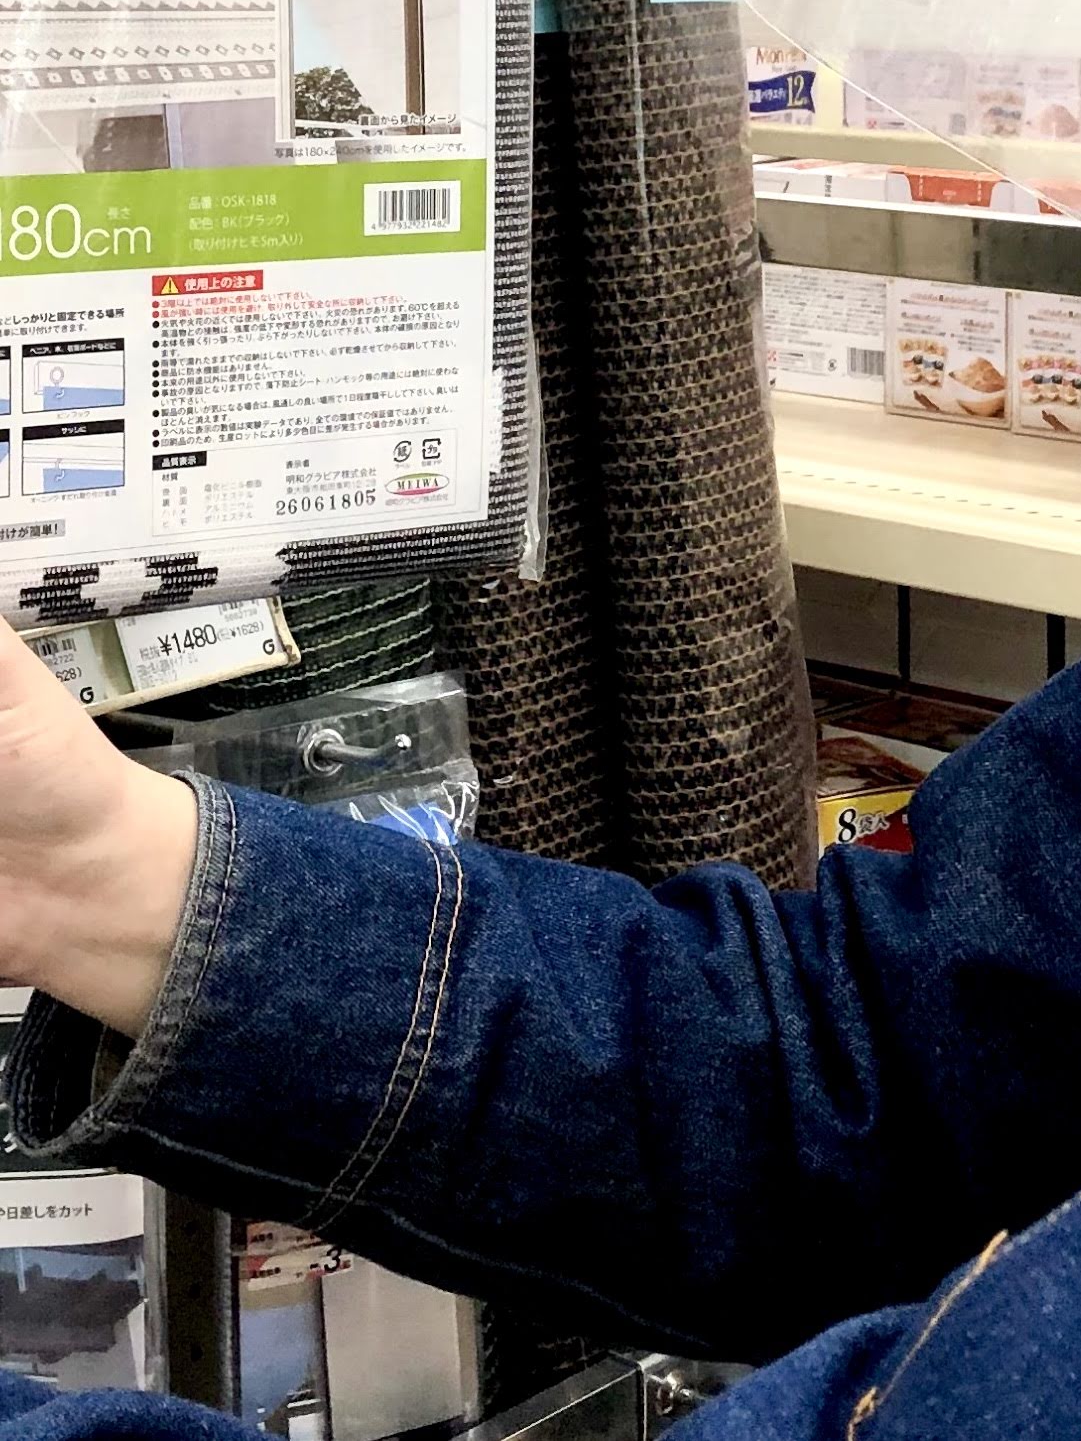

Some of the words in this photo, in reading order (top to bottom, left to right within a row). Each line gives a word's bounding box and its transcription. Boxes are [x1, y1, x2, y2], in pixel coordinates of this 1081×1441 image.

[184, 274, 257, 292] 使用上の注意
[275, 488, 377, 517] 26061805
[79, 686, 95, 705] G
